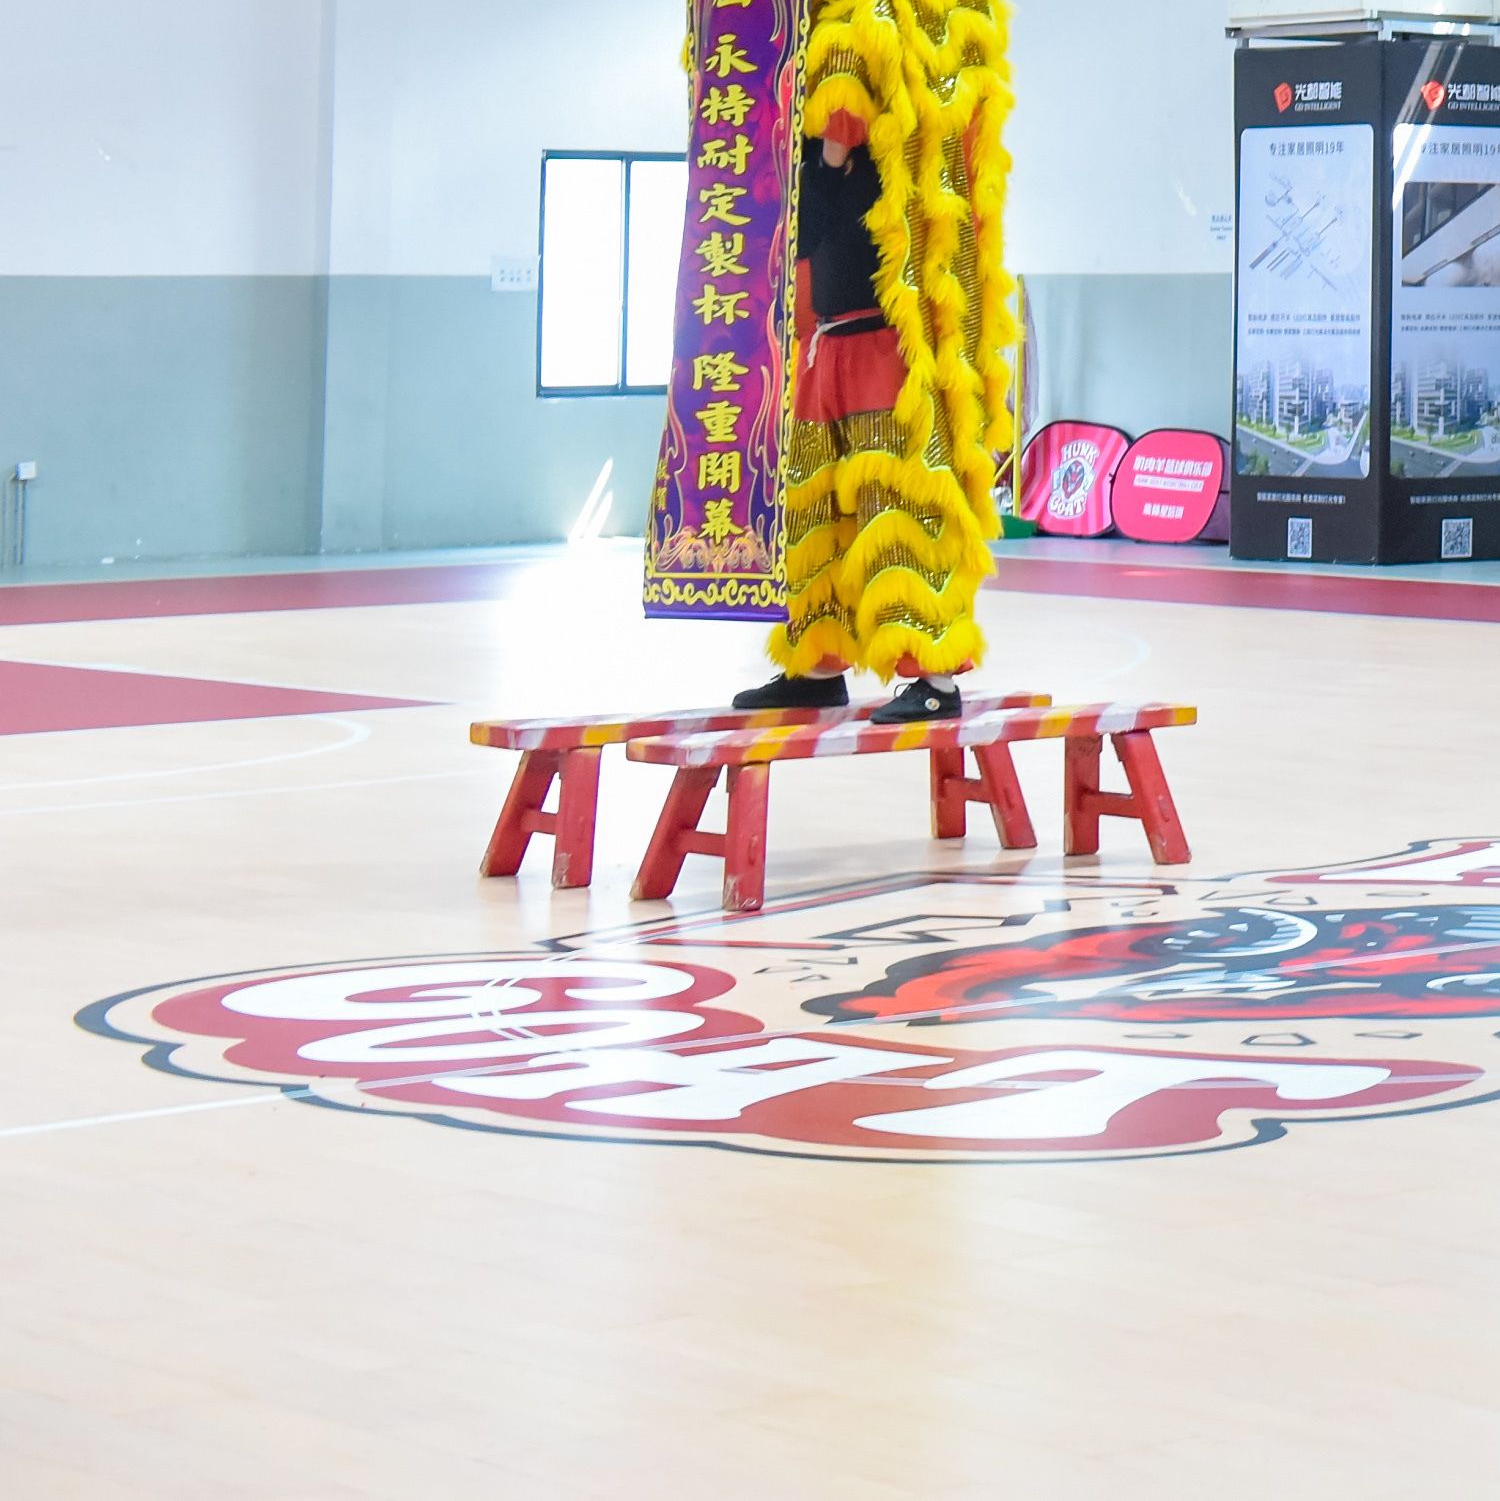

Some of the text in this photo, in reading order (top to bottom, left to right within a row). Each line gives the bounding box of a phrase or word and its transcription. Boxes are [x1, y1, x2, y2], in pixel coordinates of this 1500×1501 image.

[693, 34, 757, 326] 永特耐定製杯
[693, 351, 749, 545] 隆重開幕
[1050, 496, 1087, 516] GOAT
[1062, 442, 1099, 464] HUNK
[223, 960, 1391, 1140] GOAT
